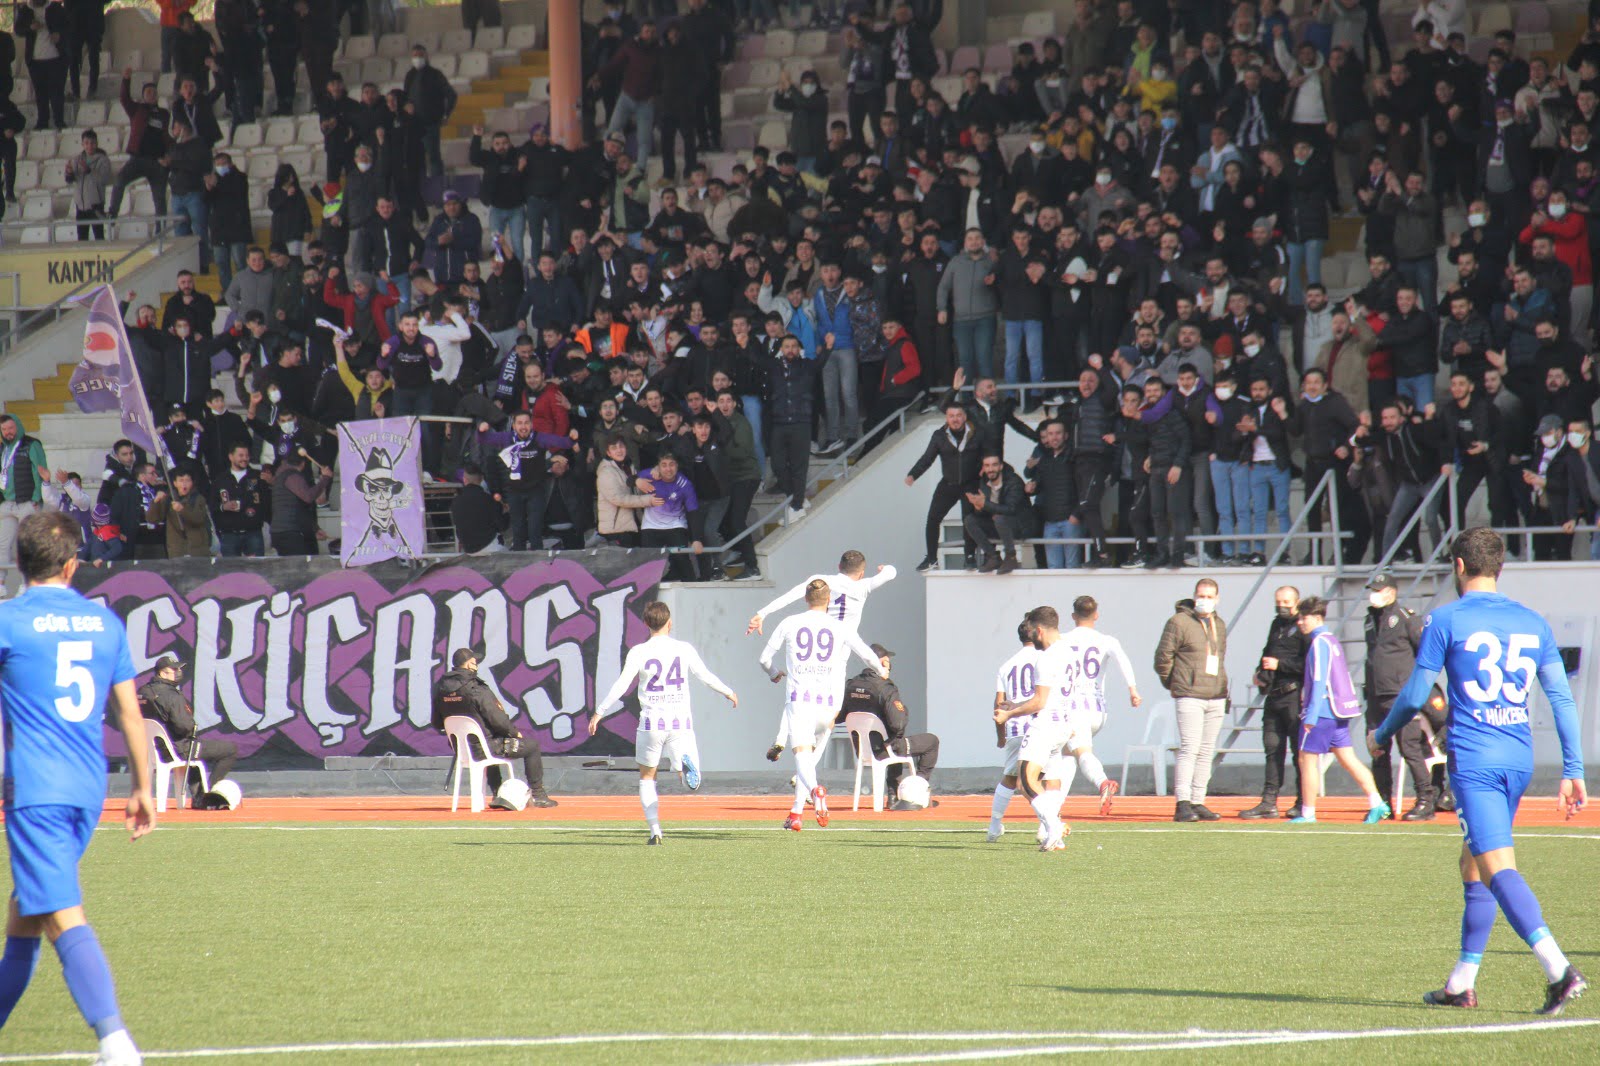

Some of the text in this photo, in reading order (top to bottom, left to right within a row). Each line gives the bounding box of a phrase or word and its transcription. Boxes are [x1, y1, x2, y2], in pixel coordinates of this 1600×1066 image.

[47, 254, 114, 284] KANTİN
[32, 613, 104, 632] GÜR EGE
[795, 626, 834, 662] 99
[53, 640, 96, 723] 5
[88, 585, 634, 747] SKİÇARŞI
[644, 656, 685, 692] 24
[1007, 662, 1036, 700] 10
[1463, 631, 1540, 704] 35
